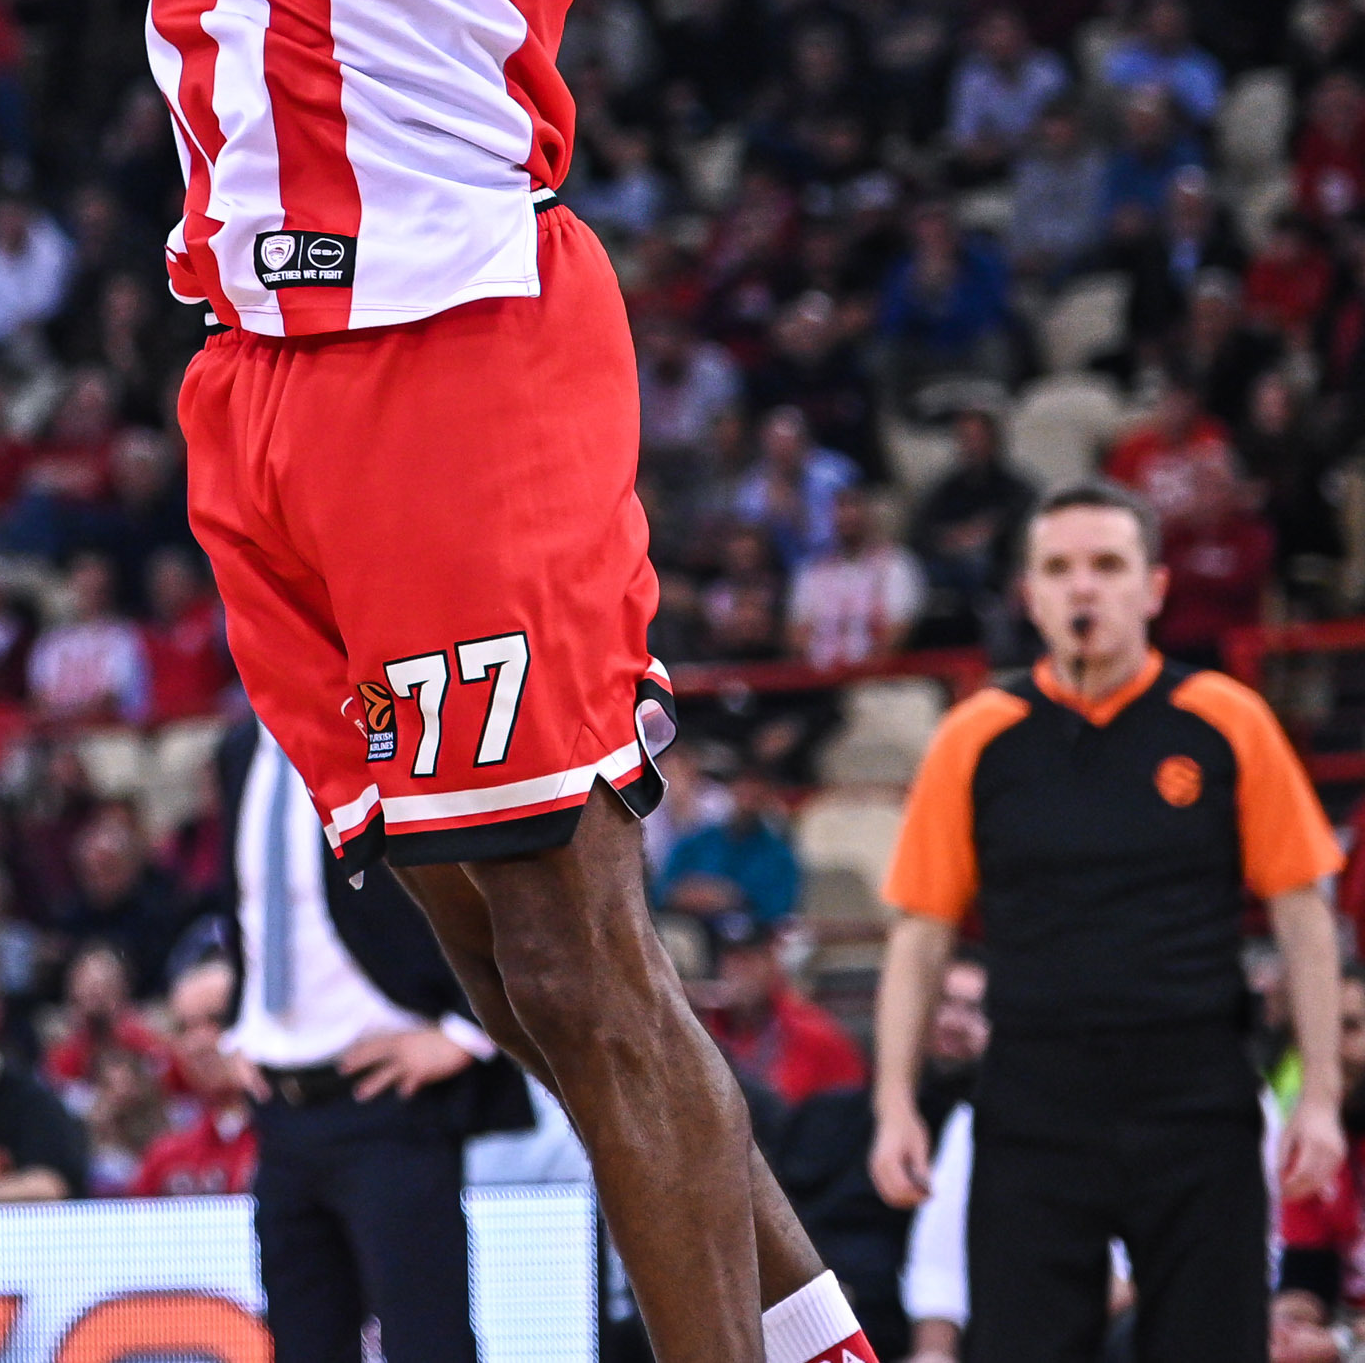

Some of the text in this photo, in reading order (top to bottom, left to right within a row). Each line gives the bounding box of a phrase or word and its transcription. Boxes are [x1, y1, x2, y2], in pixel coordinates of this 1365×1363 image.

[262, 269, 344, 284] TOGETHER WE FIGHT
[382, 630, 531, 779] 77
